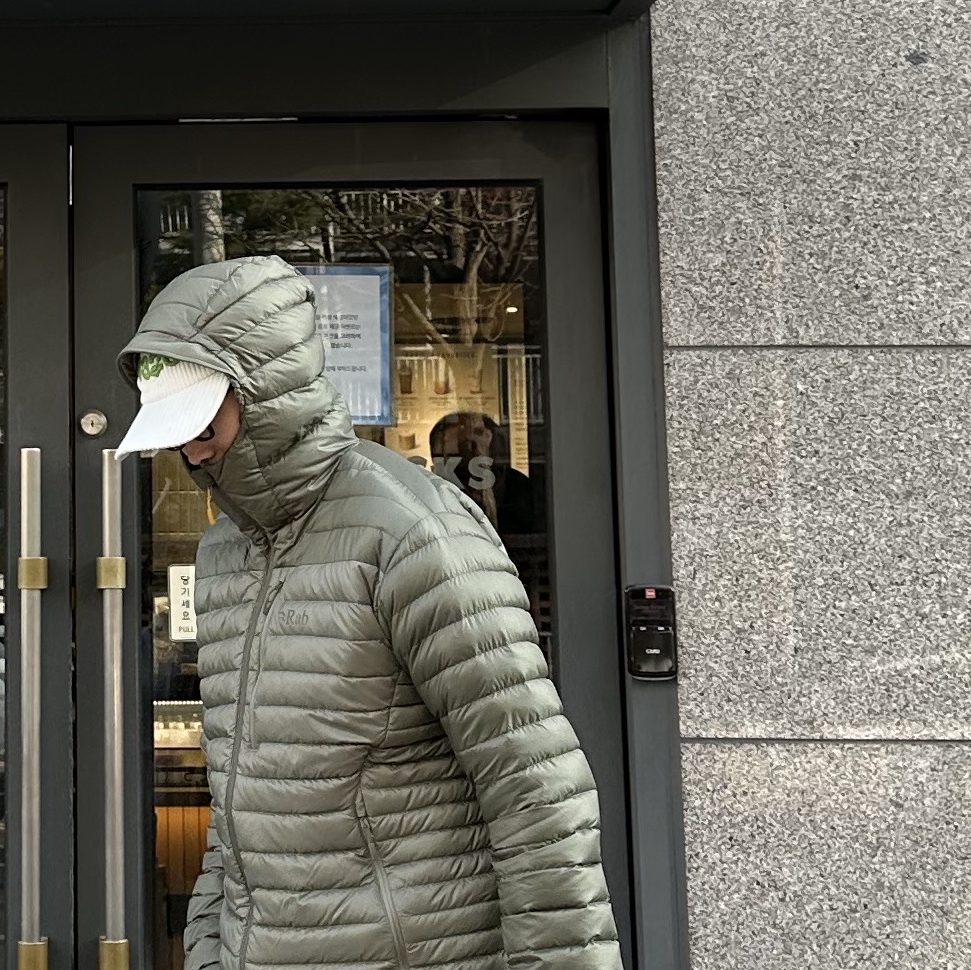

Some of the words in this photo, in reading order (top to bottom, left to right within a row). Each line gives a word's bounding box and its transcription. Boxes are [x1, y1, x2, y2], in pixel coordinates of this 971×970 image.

[180, 575, 191, 621] 당기세요
[285, 609, 310, 626] Rab
[178, 625, 195, 633] PULL
